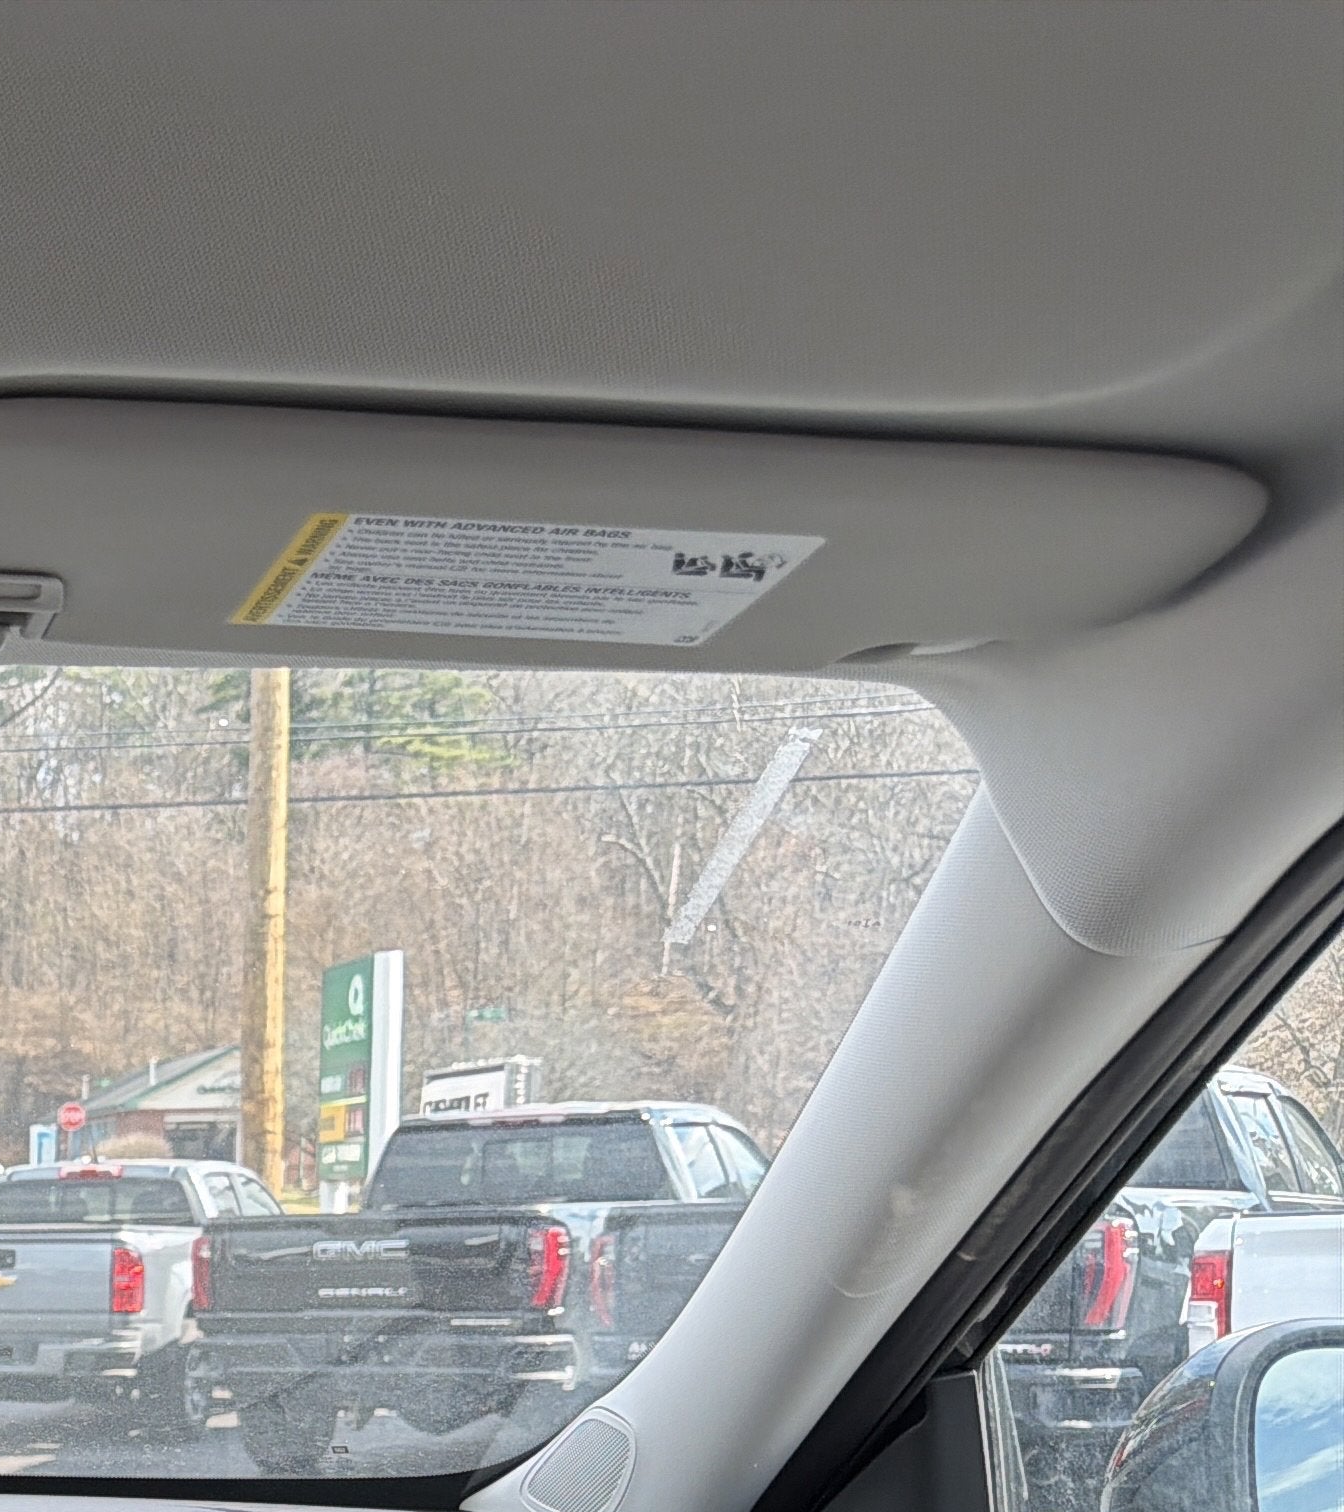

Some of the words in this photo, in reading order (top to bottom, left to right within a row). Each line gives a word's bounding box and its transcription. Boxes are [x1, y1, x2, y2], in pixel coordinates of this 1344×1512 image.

[354, 517, 399, 527] EVEN
[403, 518, 448, 529] WITH
[453, 522, 545, 535] ADVANCED
[549, 526, 581, 536] AIR
[583, 528, 632, 539] BAGS
[312, 1239, 411, 1260] GMC
